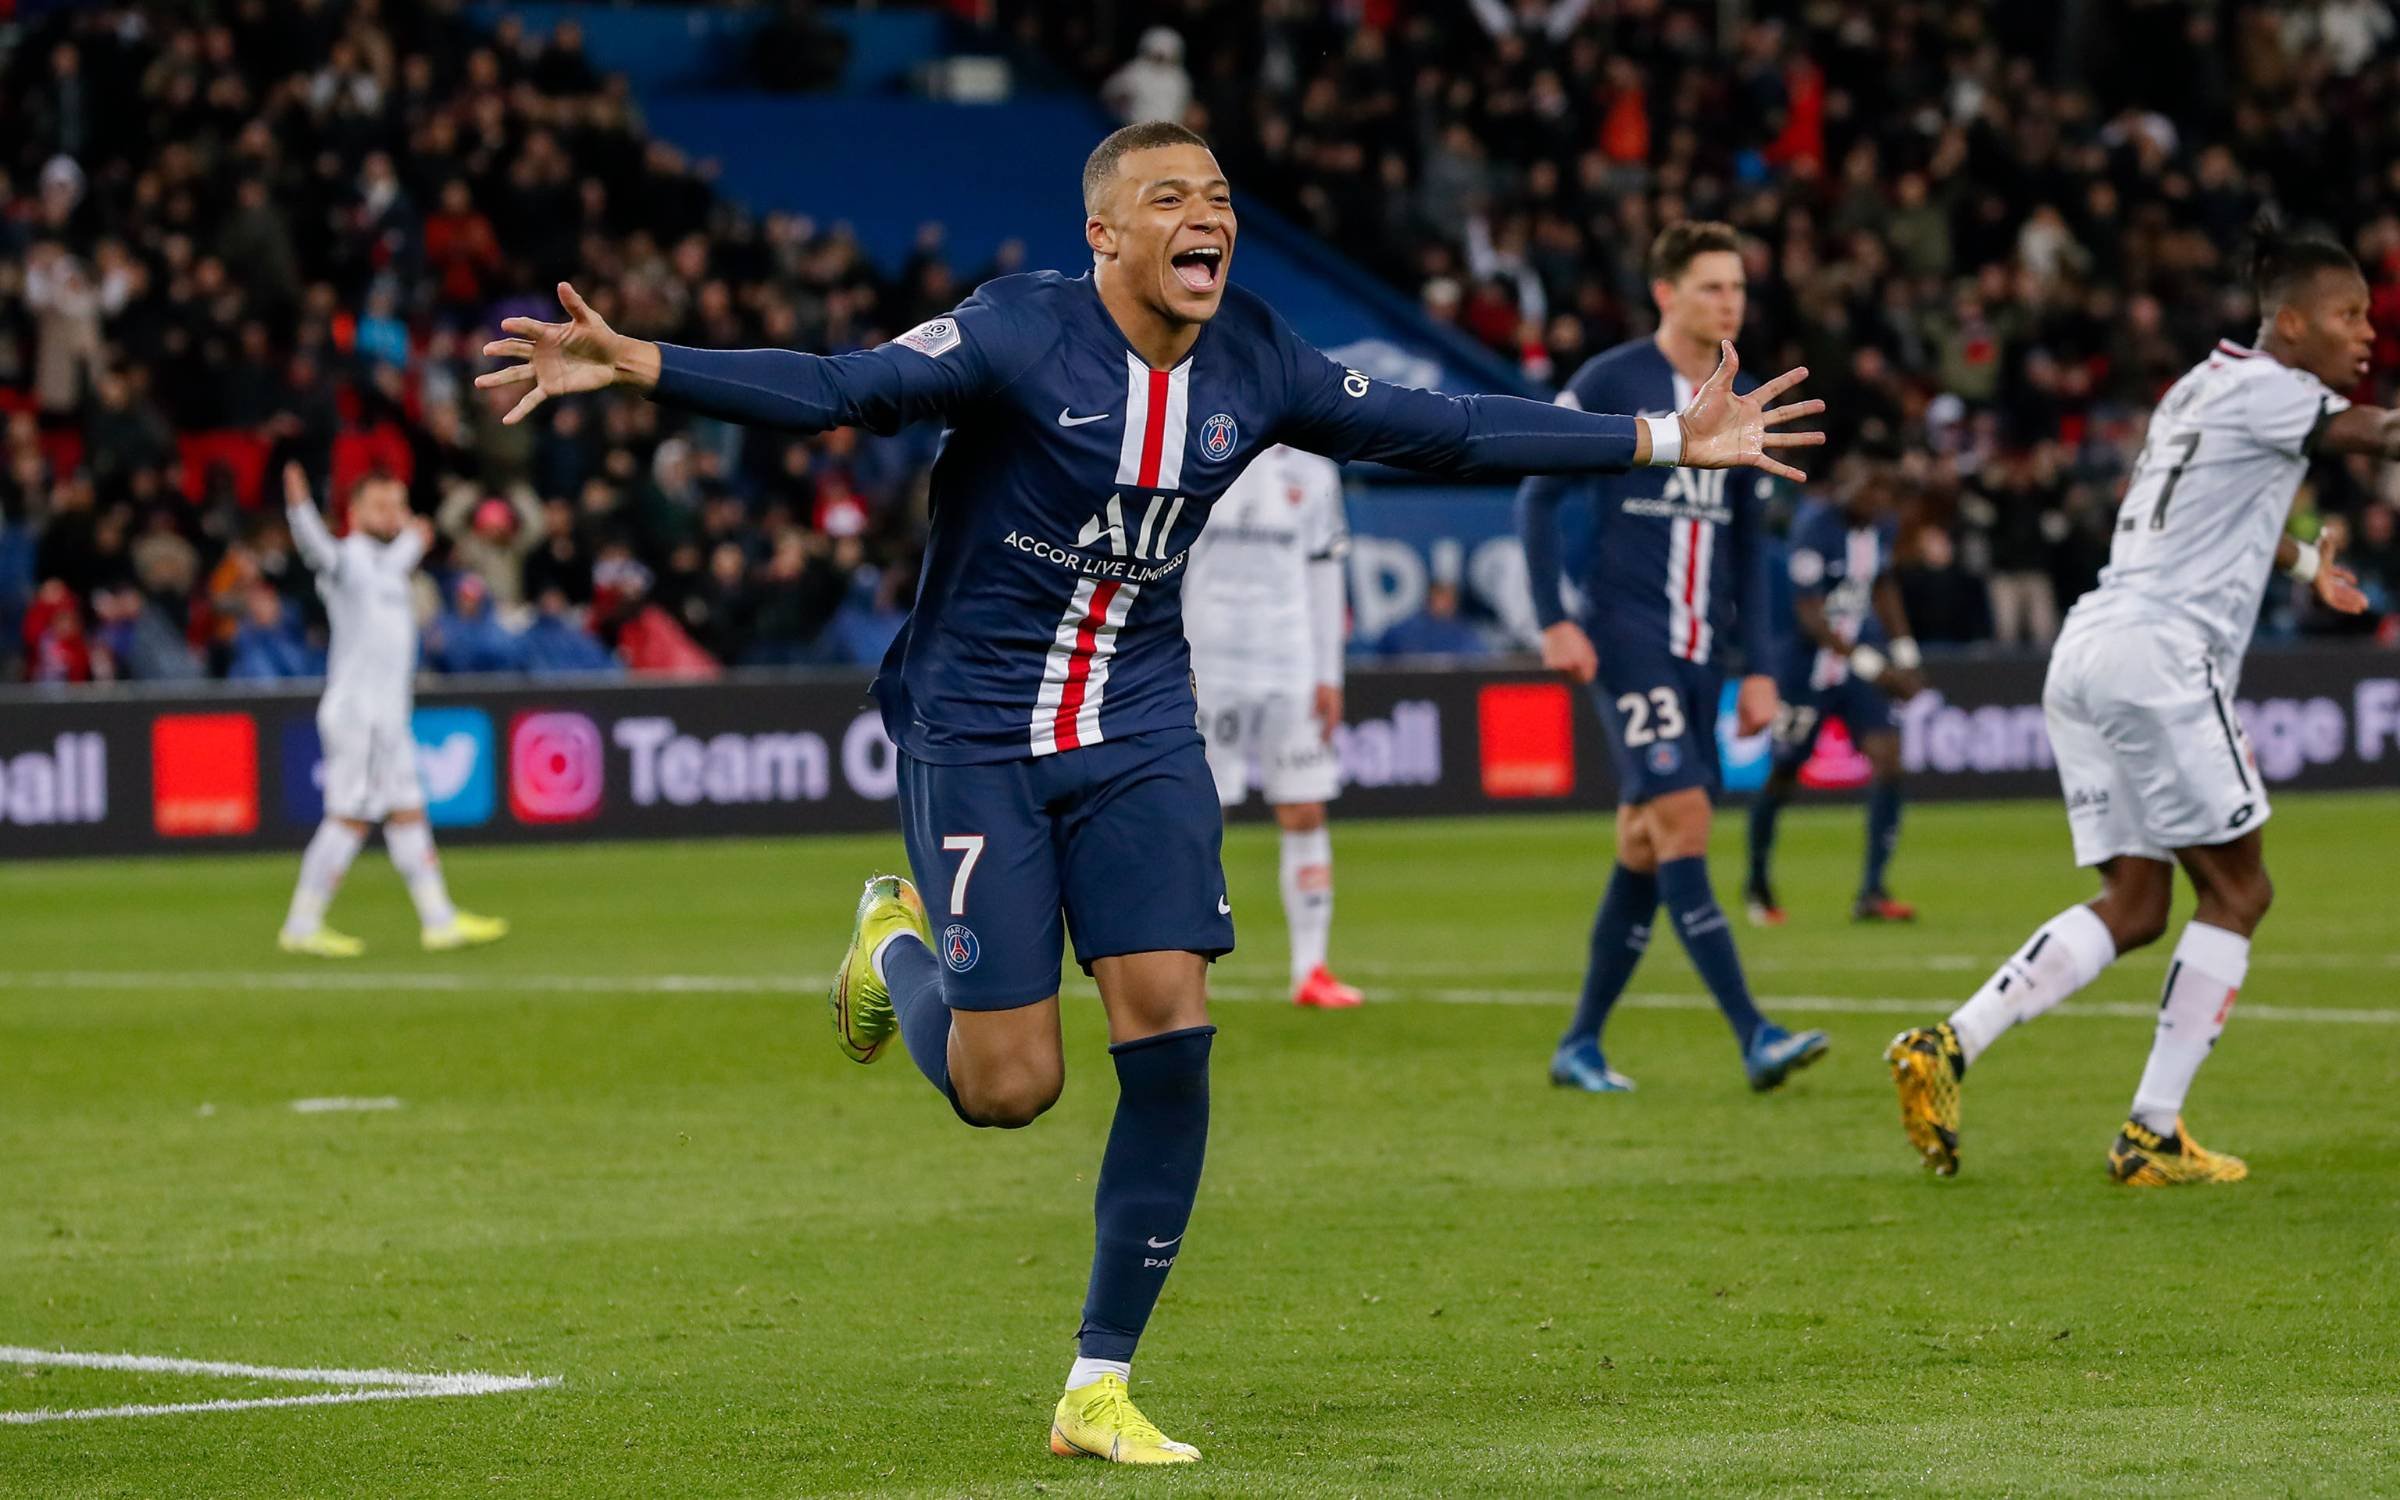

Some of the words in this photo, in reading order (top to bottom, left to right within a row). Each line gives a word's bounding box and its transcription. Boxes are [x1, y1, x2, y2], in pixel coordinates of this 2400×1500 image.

[1208, 416, 1233, 429] PARIS
[1003, 530, 1080, 571] ACCOR
[1082, 558, 1126, 577] LIVE
[1616, 685, 1686, 748] 23
[0, 731, 108, 826] all
[612, 716, 829, 807] Team
[943, 835, 984, 915] 7
[946, 926, 970, 940] PARIS
